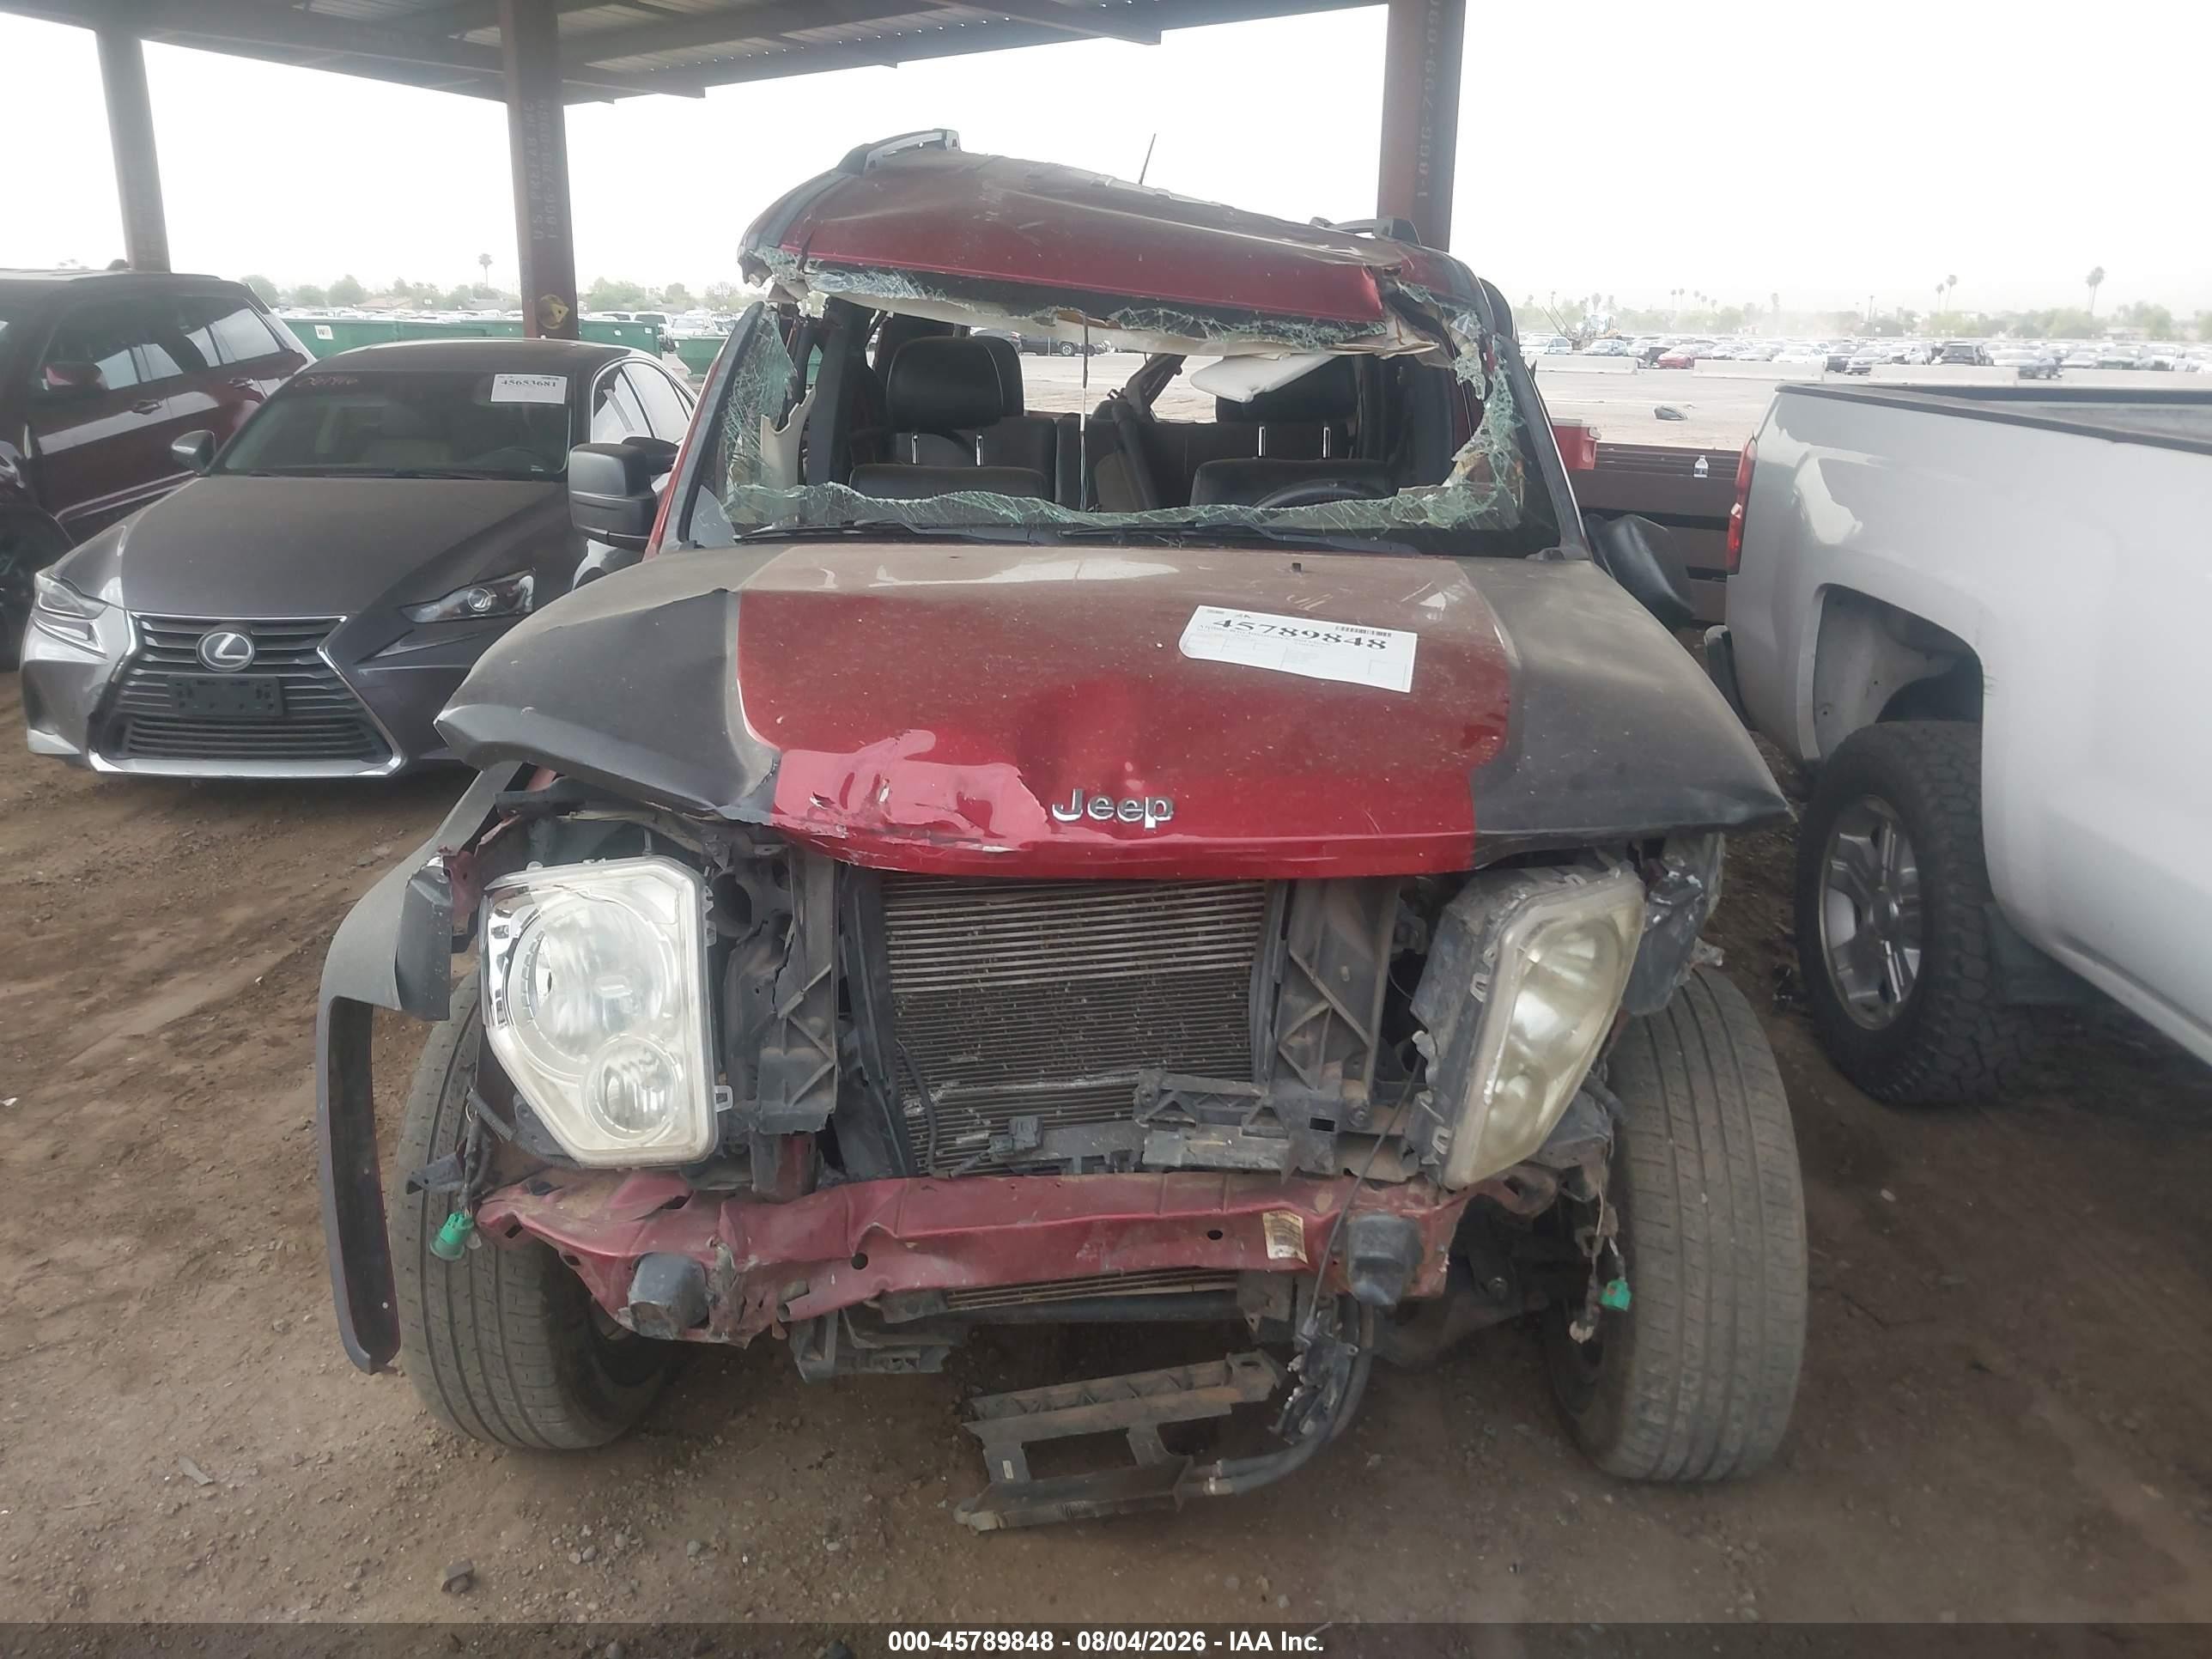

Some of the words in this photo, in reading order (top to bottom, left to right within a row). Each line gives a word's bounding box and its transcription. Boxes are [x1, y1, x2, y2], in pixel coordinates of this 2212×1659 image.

[501, 380, 557, 388] 45653681
[1212, 618, 1388, 651] 45789848
[1052, 788, 1174, 829] Jeep
